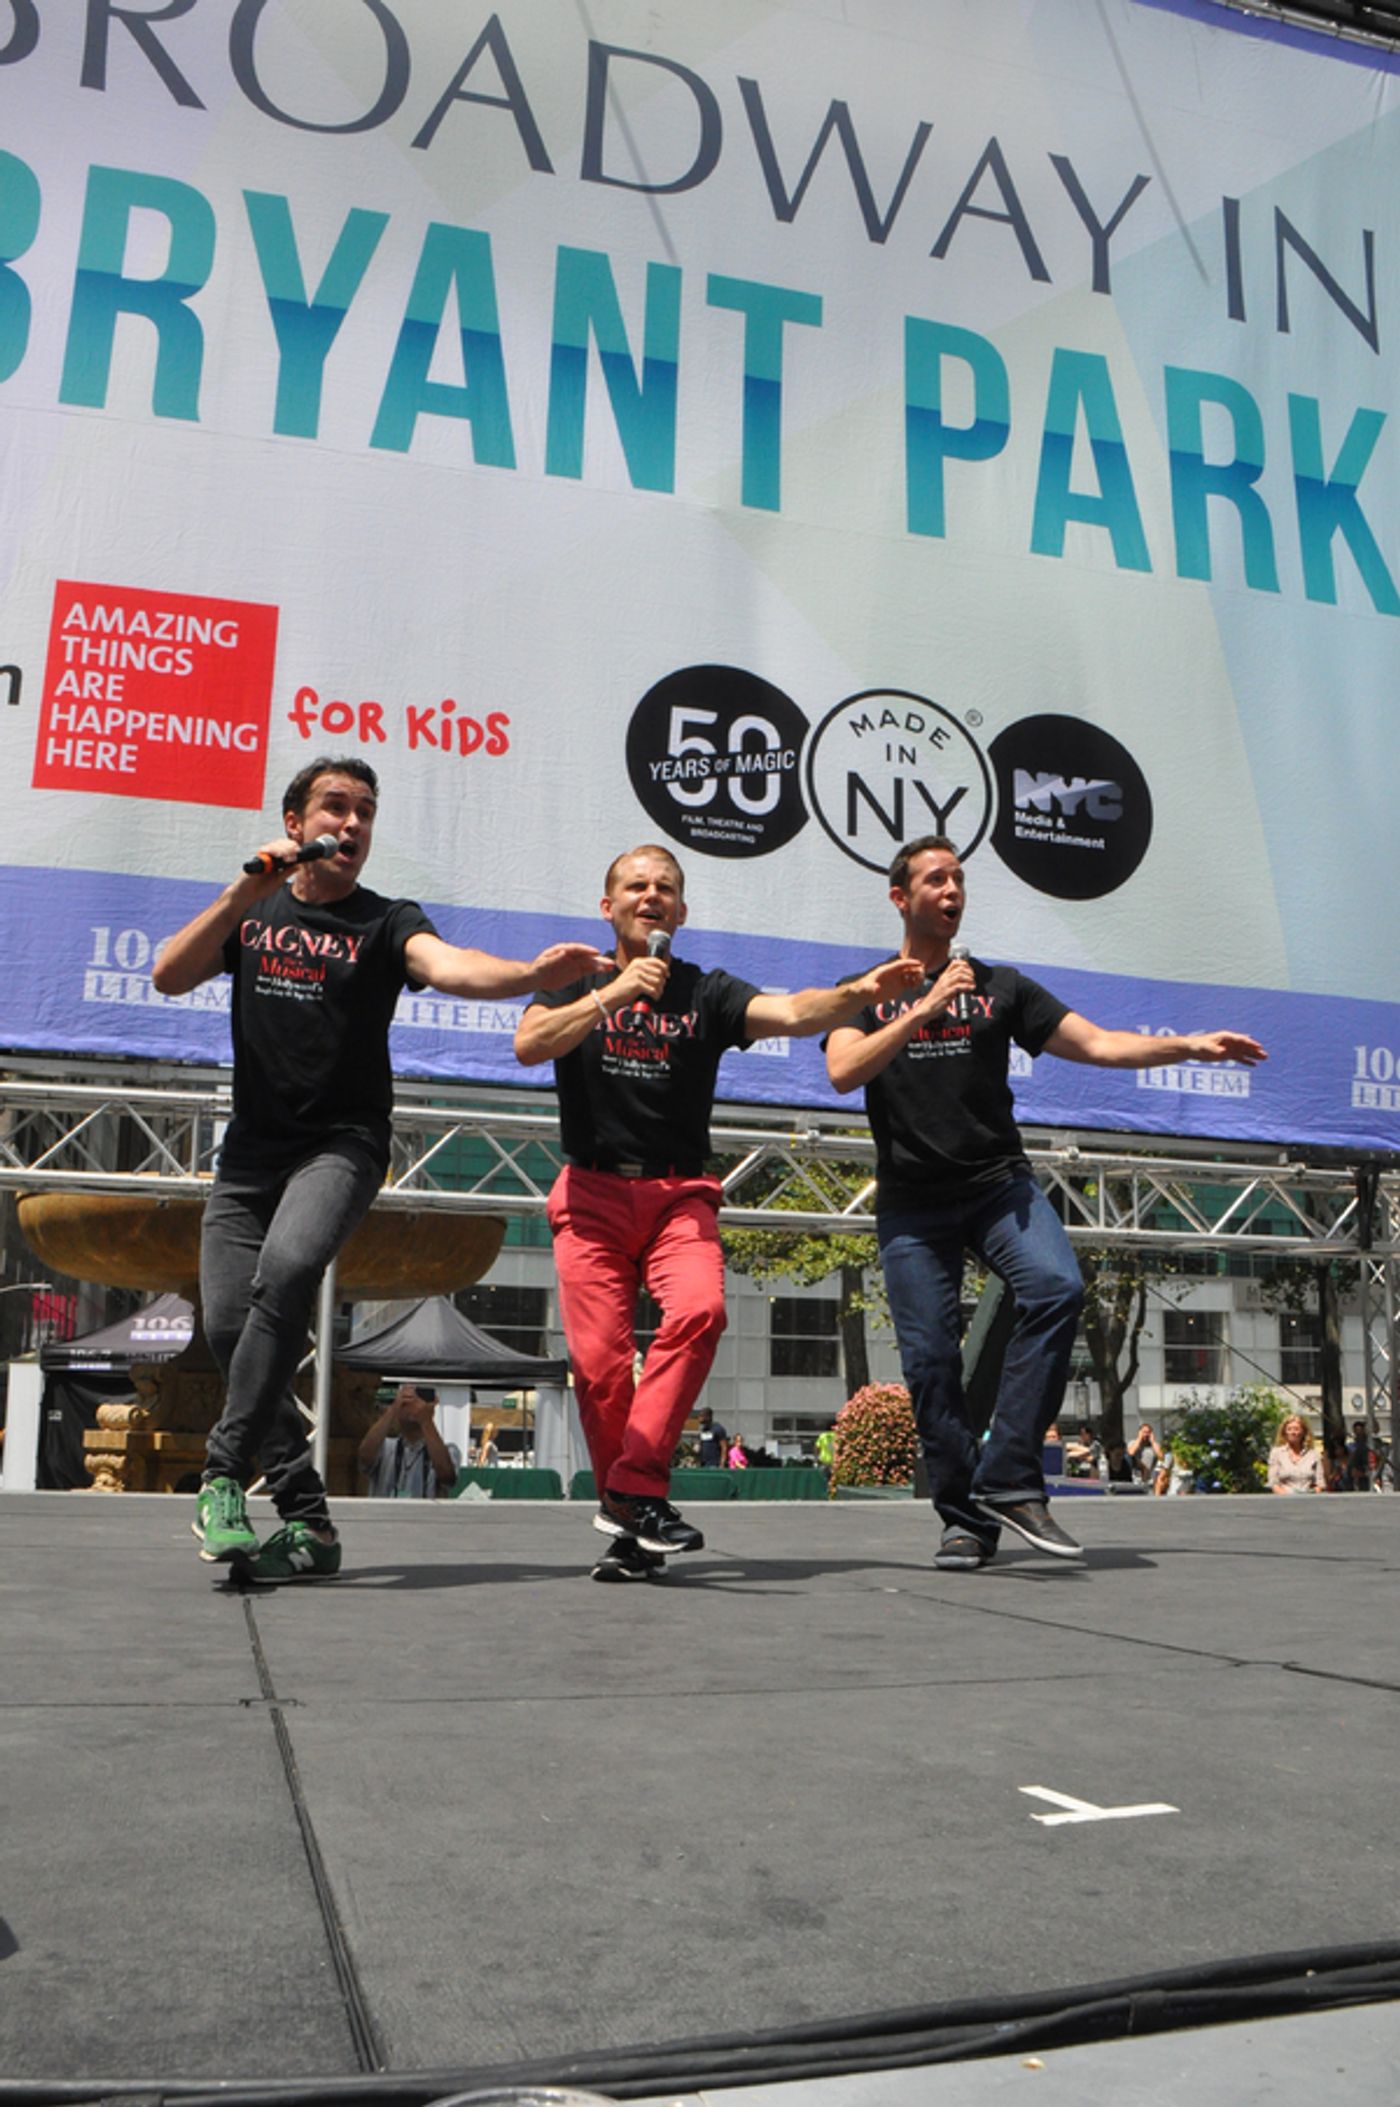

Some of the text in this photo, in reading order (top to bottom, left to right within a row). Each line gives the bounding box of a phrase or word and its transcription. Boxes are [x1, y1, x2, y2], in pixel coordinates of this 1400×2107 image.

[1221, 195, 1381, 356] IN
[904, 314, 1400, 618] PARK
[61, 602, 240, 649] AMAZING
[60, 635, 194, 676] THINGS
[55, 669, 125, 702] ARE
[49, 704, 259, 752] HAPPENING
[848, 709, 951, 750] MADE
[45, 738, 138, 773] HERE
[649, 750, 796, 781] YEARS OF MAGIC
[666, 705, 782, 816] 50
[886, 743, 917, 766] IN
[847, 771, 969, 842] NY
[1013, 768, 1124, 822] NYC
[690, 828, 756, 844] BROADCASTING
[706, 817, 745, 830] THEATRE
[1015, 811, 1066, 829] Media &
[1015, 826, 1105, 849] Entertainment
[240, 919, 365, 963] CAGNEY
